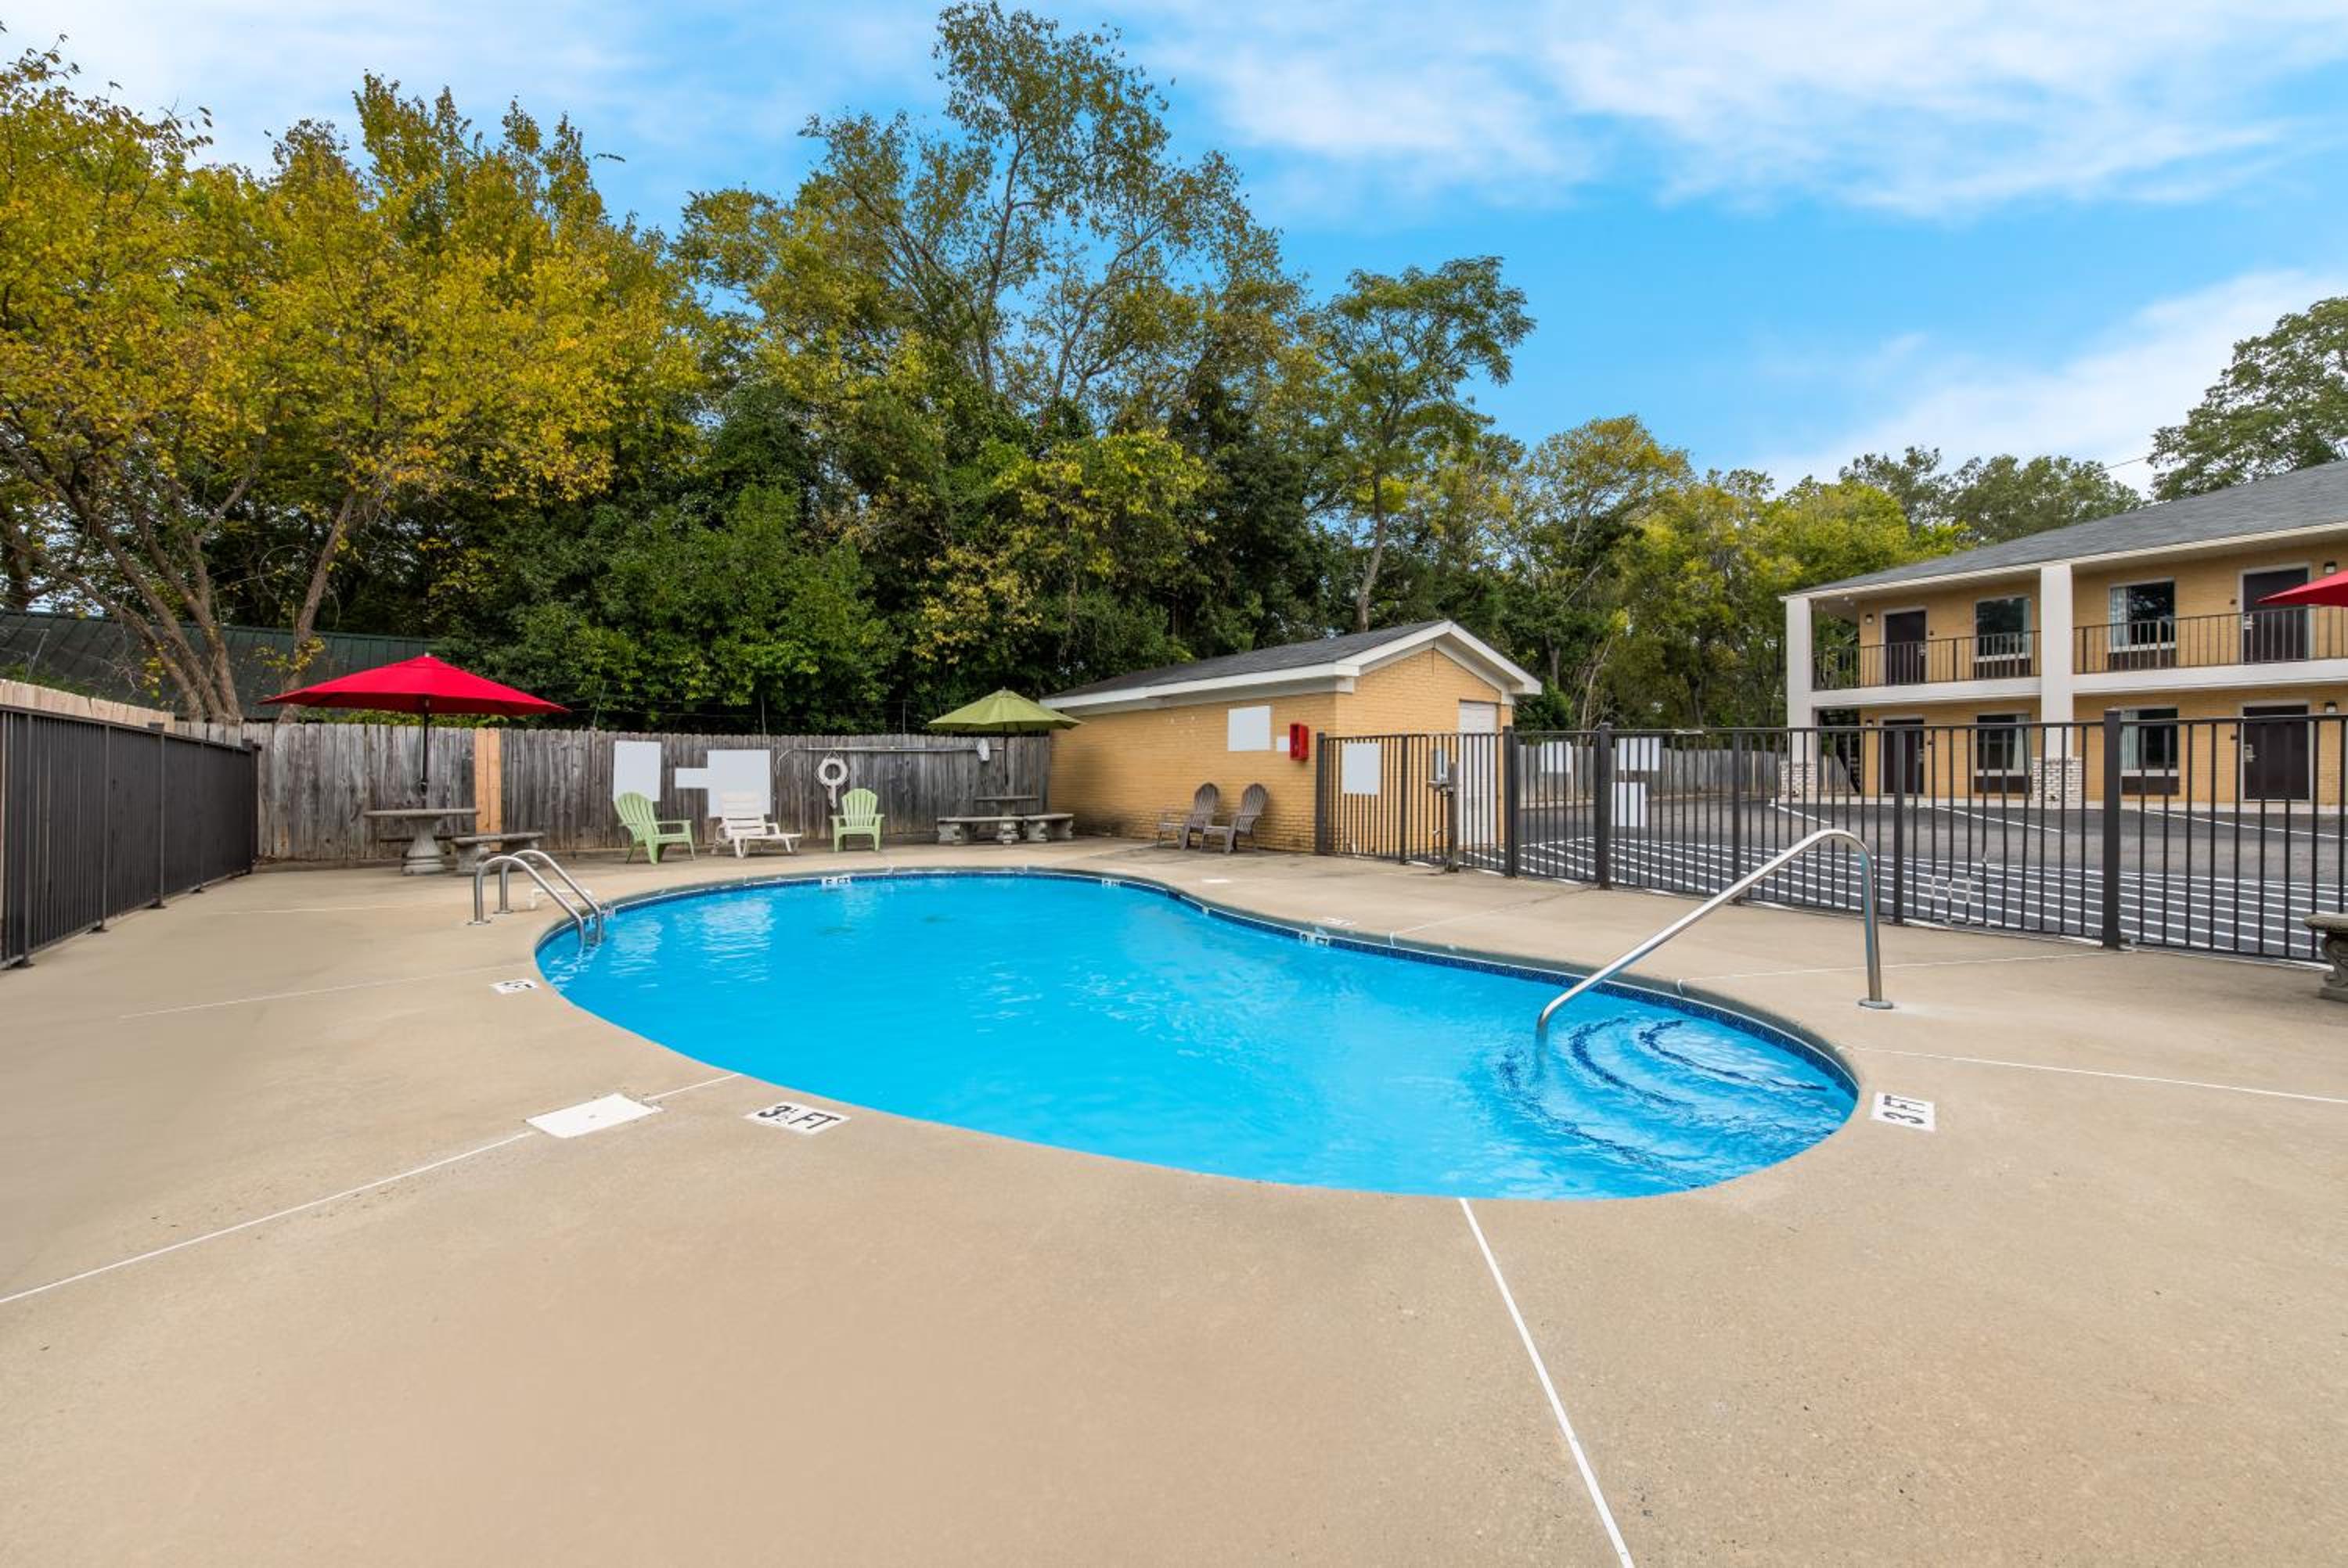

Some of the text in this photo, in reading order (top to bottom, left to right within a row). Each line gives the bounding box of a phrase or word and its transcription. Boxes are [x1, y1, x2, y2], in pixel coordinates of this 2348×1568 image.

[787, 1112, 841, 1129] FT
[1882, 1095, 1926, 1124] 3 FT
